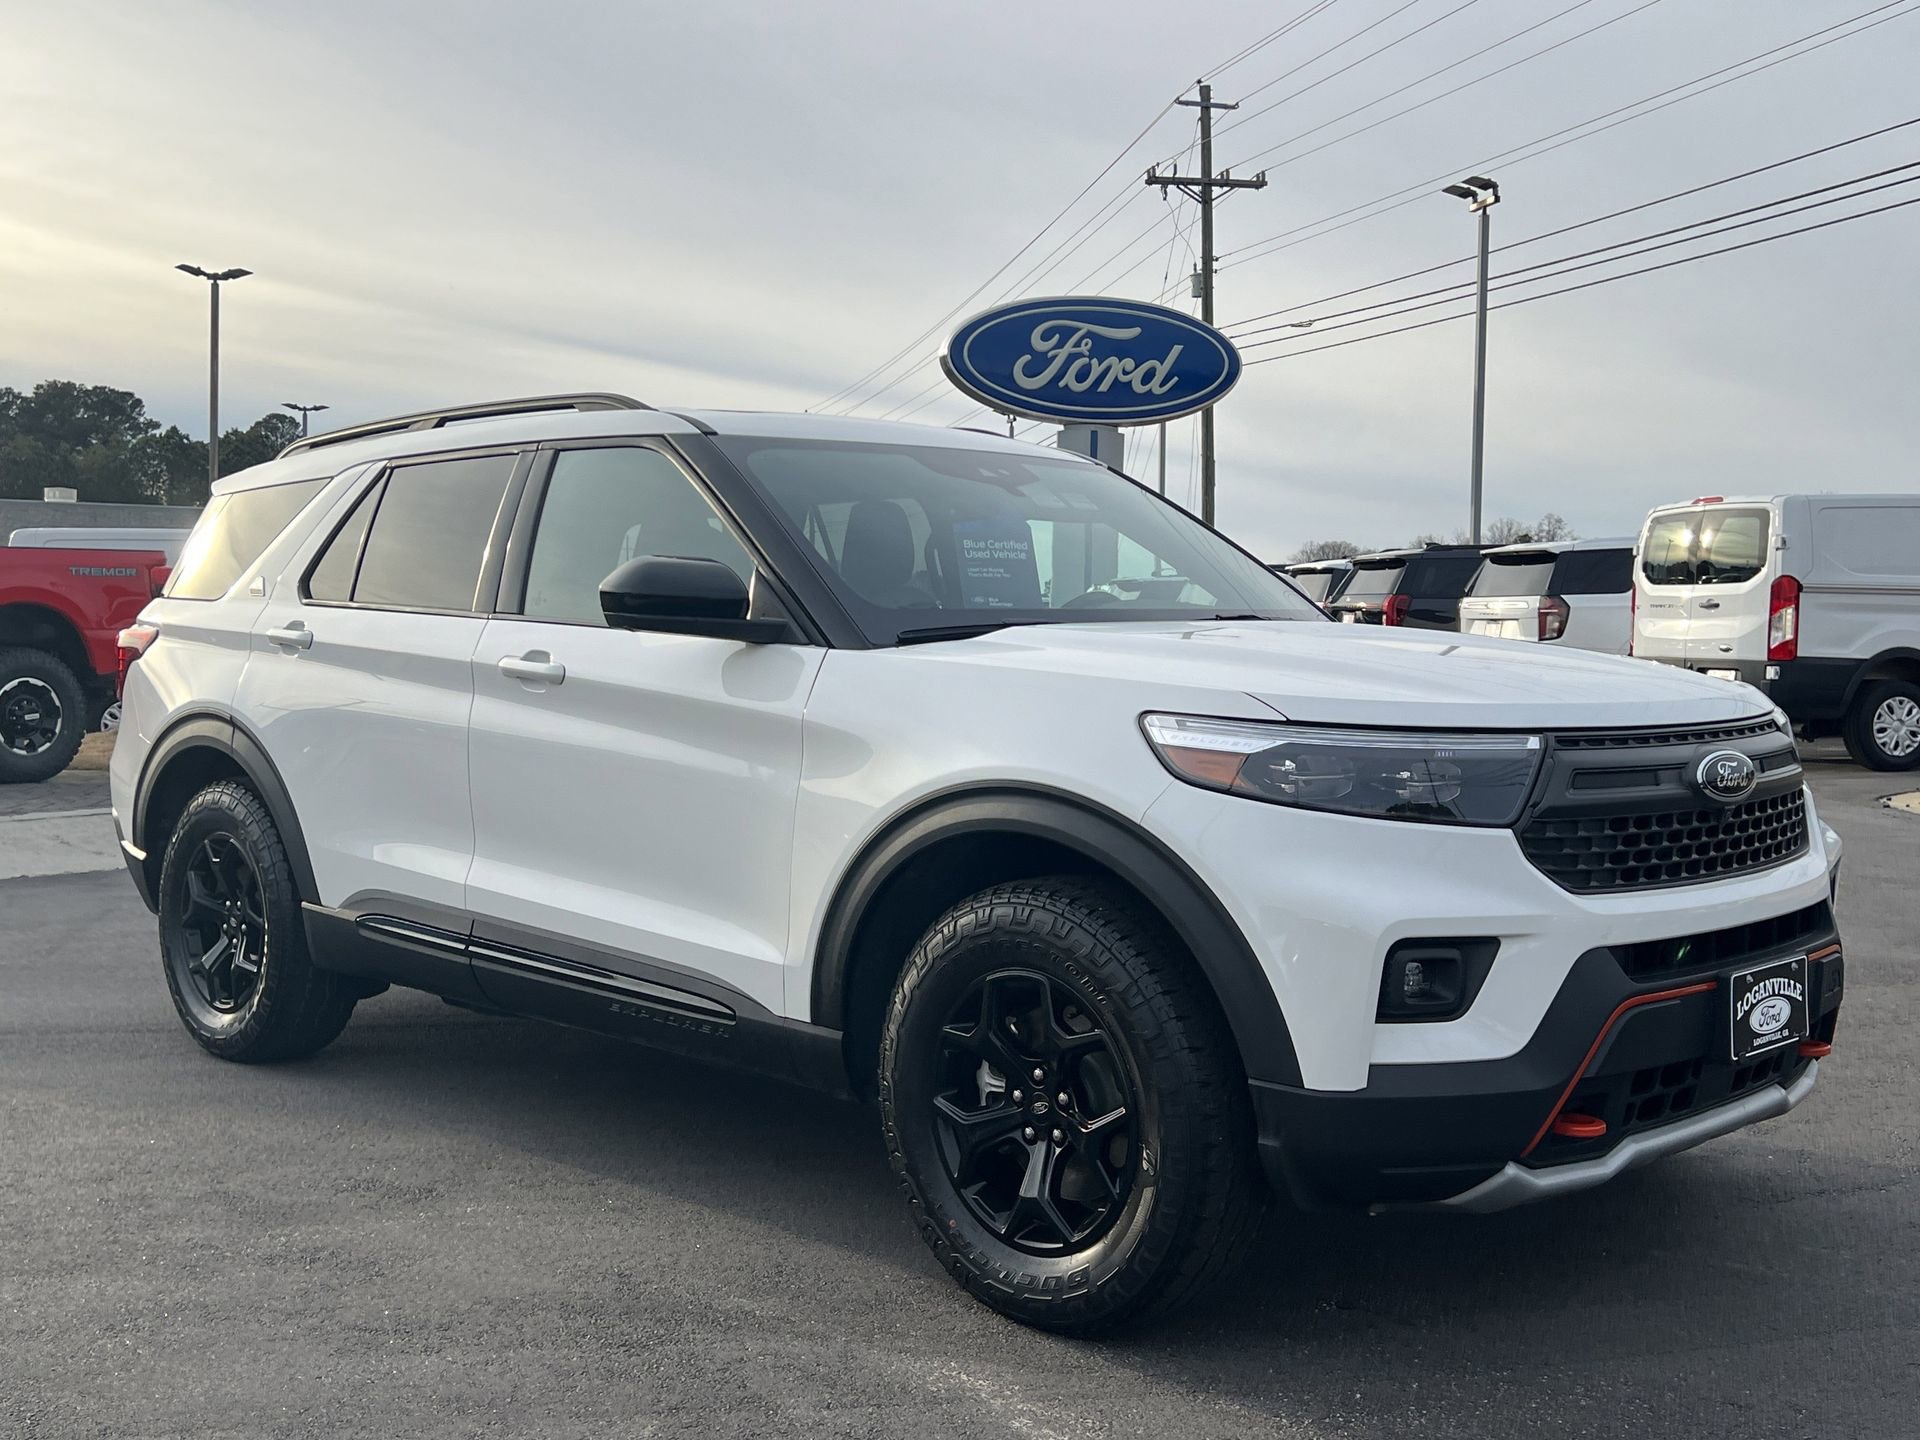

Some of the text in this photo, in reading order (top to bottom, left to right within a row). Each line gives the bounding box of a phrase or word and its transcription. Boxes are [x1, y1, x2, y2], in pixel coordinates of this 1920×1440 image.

[1012, 320, 1185, 395] Ford
[963, 539, 1028, 550] Blue Certified
[965, 549, 1027, 560] Used Vehicle
[69, 567, 137, 577] TREMOR
[1717, 761, 1748, 787] Ford
[1736, 977, 1803, 1021] LOGANVILLE
[1759, 1004, 1782, 1028] Ford
